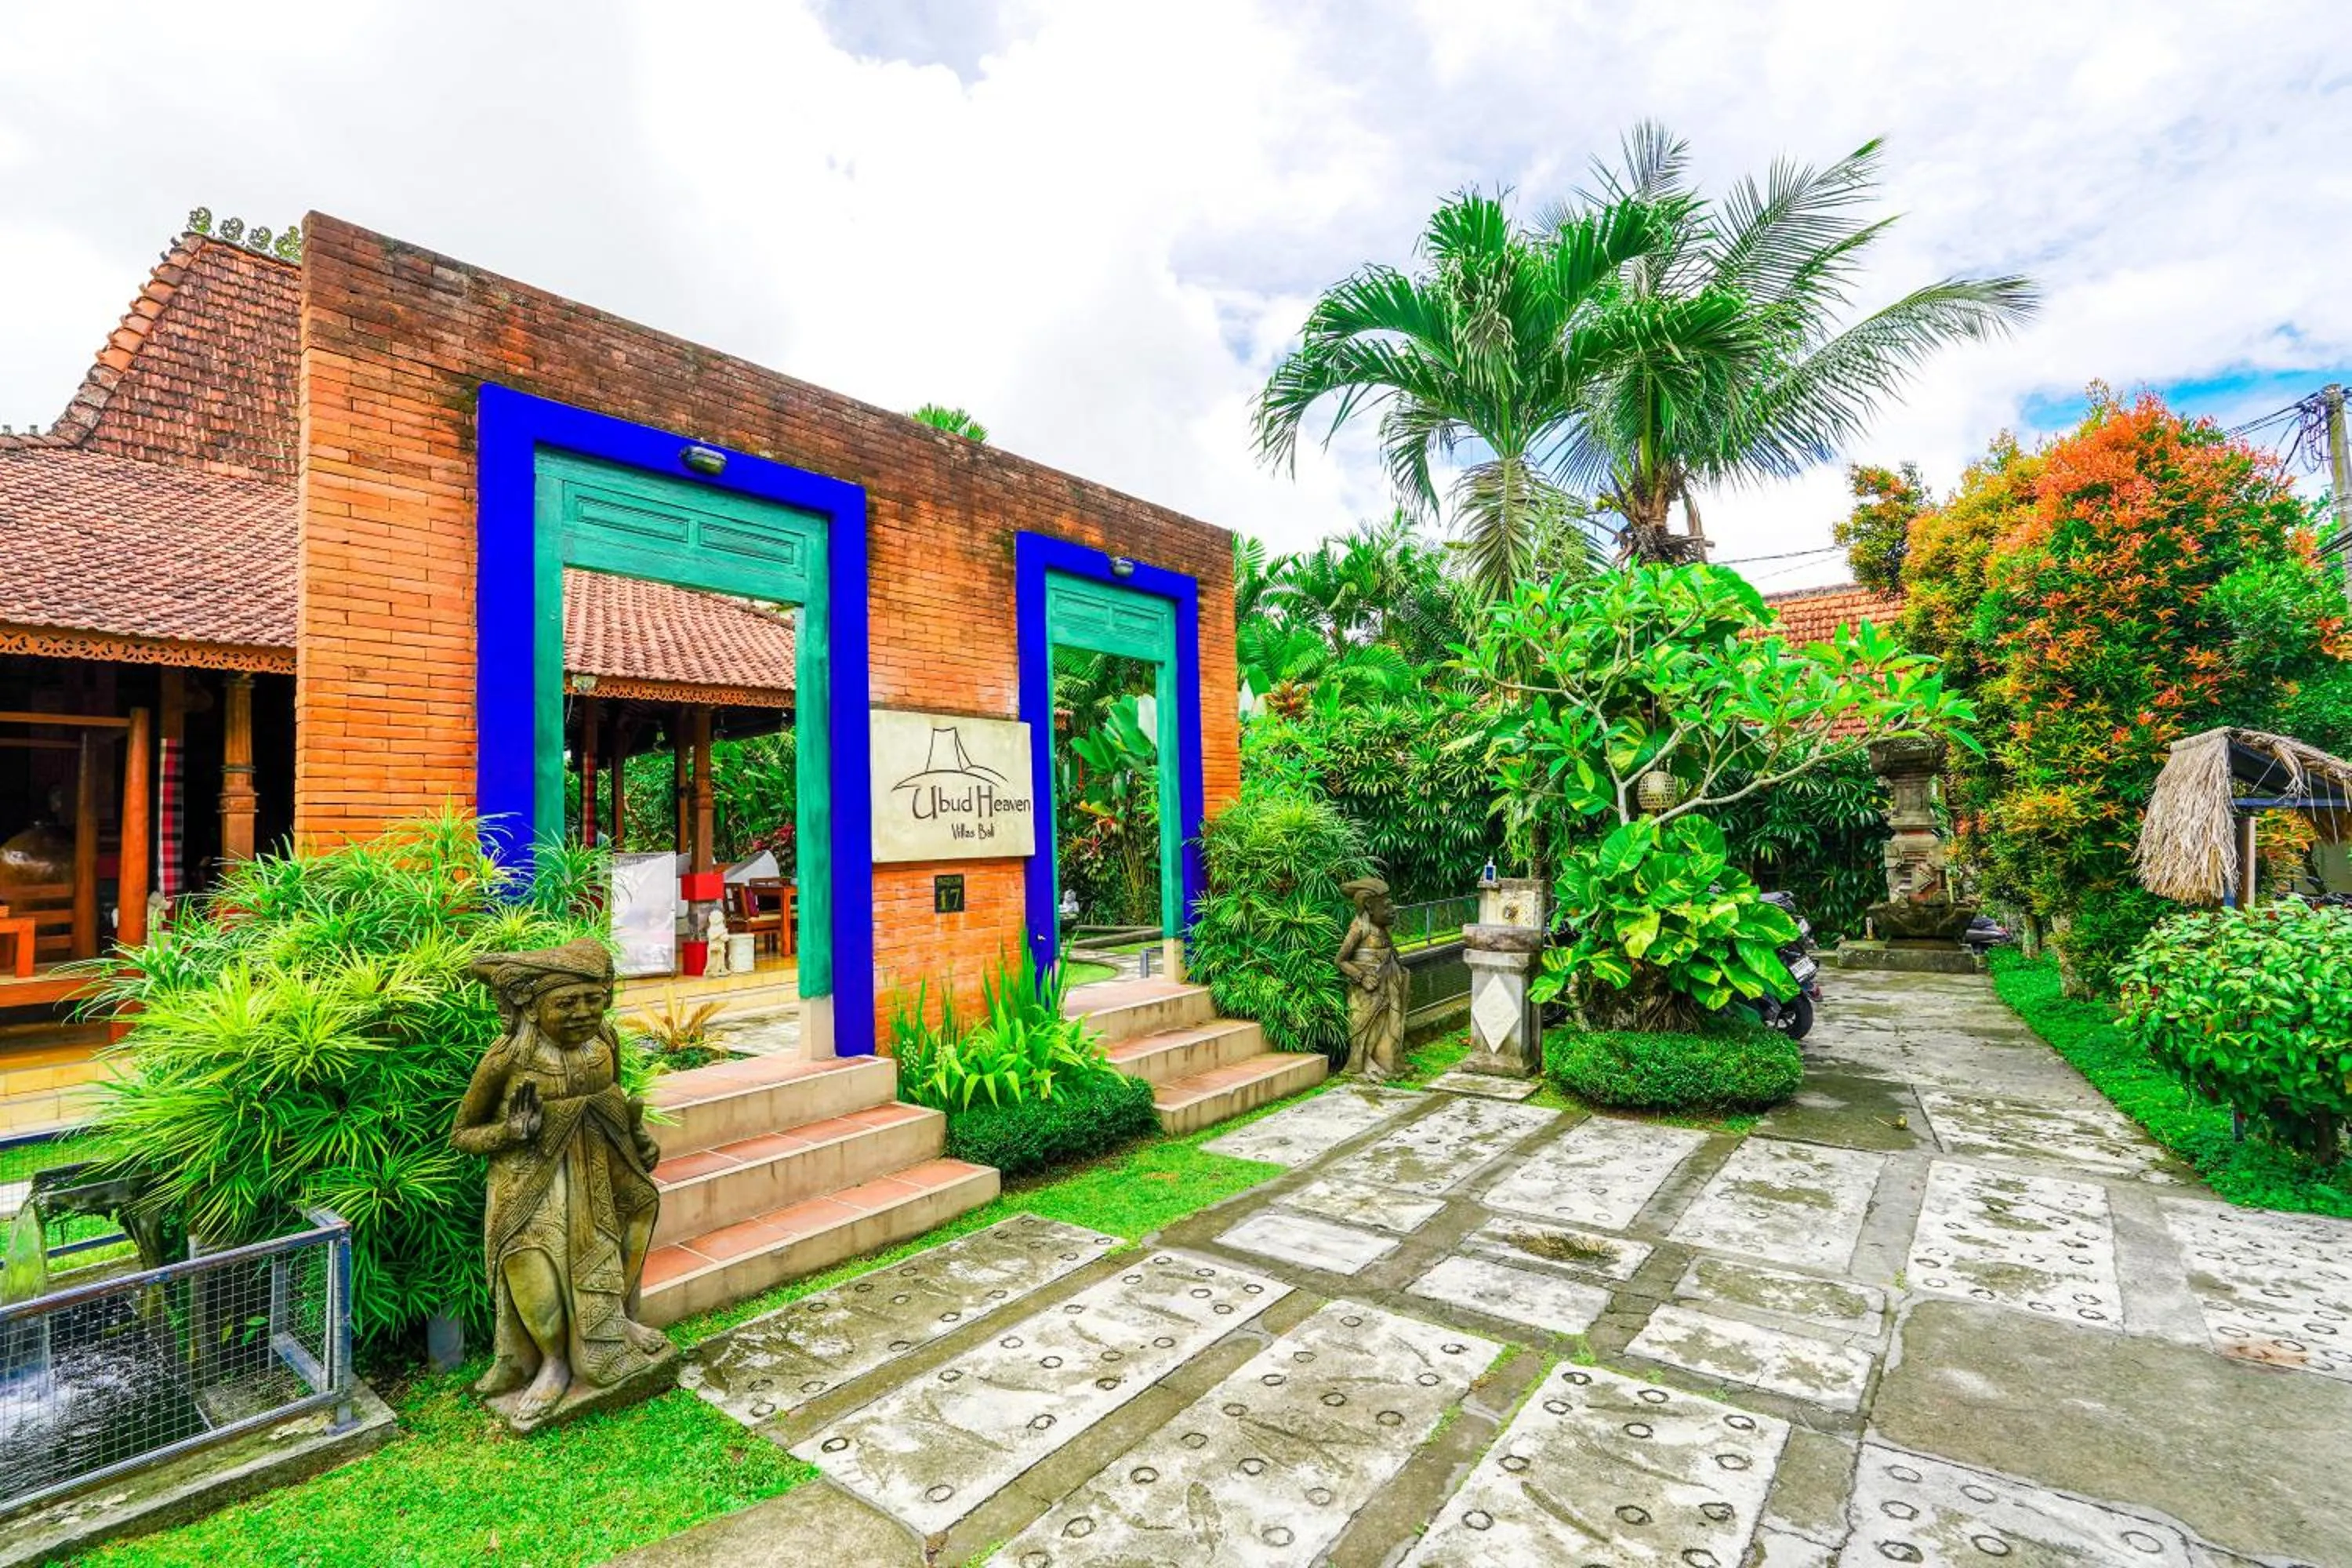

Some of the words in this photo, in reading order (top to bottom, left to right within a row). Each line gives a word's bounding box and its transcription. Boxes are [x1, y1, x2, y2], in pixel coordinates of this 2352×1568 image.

[912, 785, 973, 820] Ubud
[976, 785, 1031, 818] Heaven
[950, 822, 975, 840] Villas
